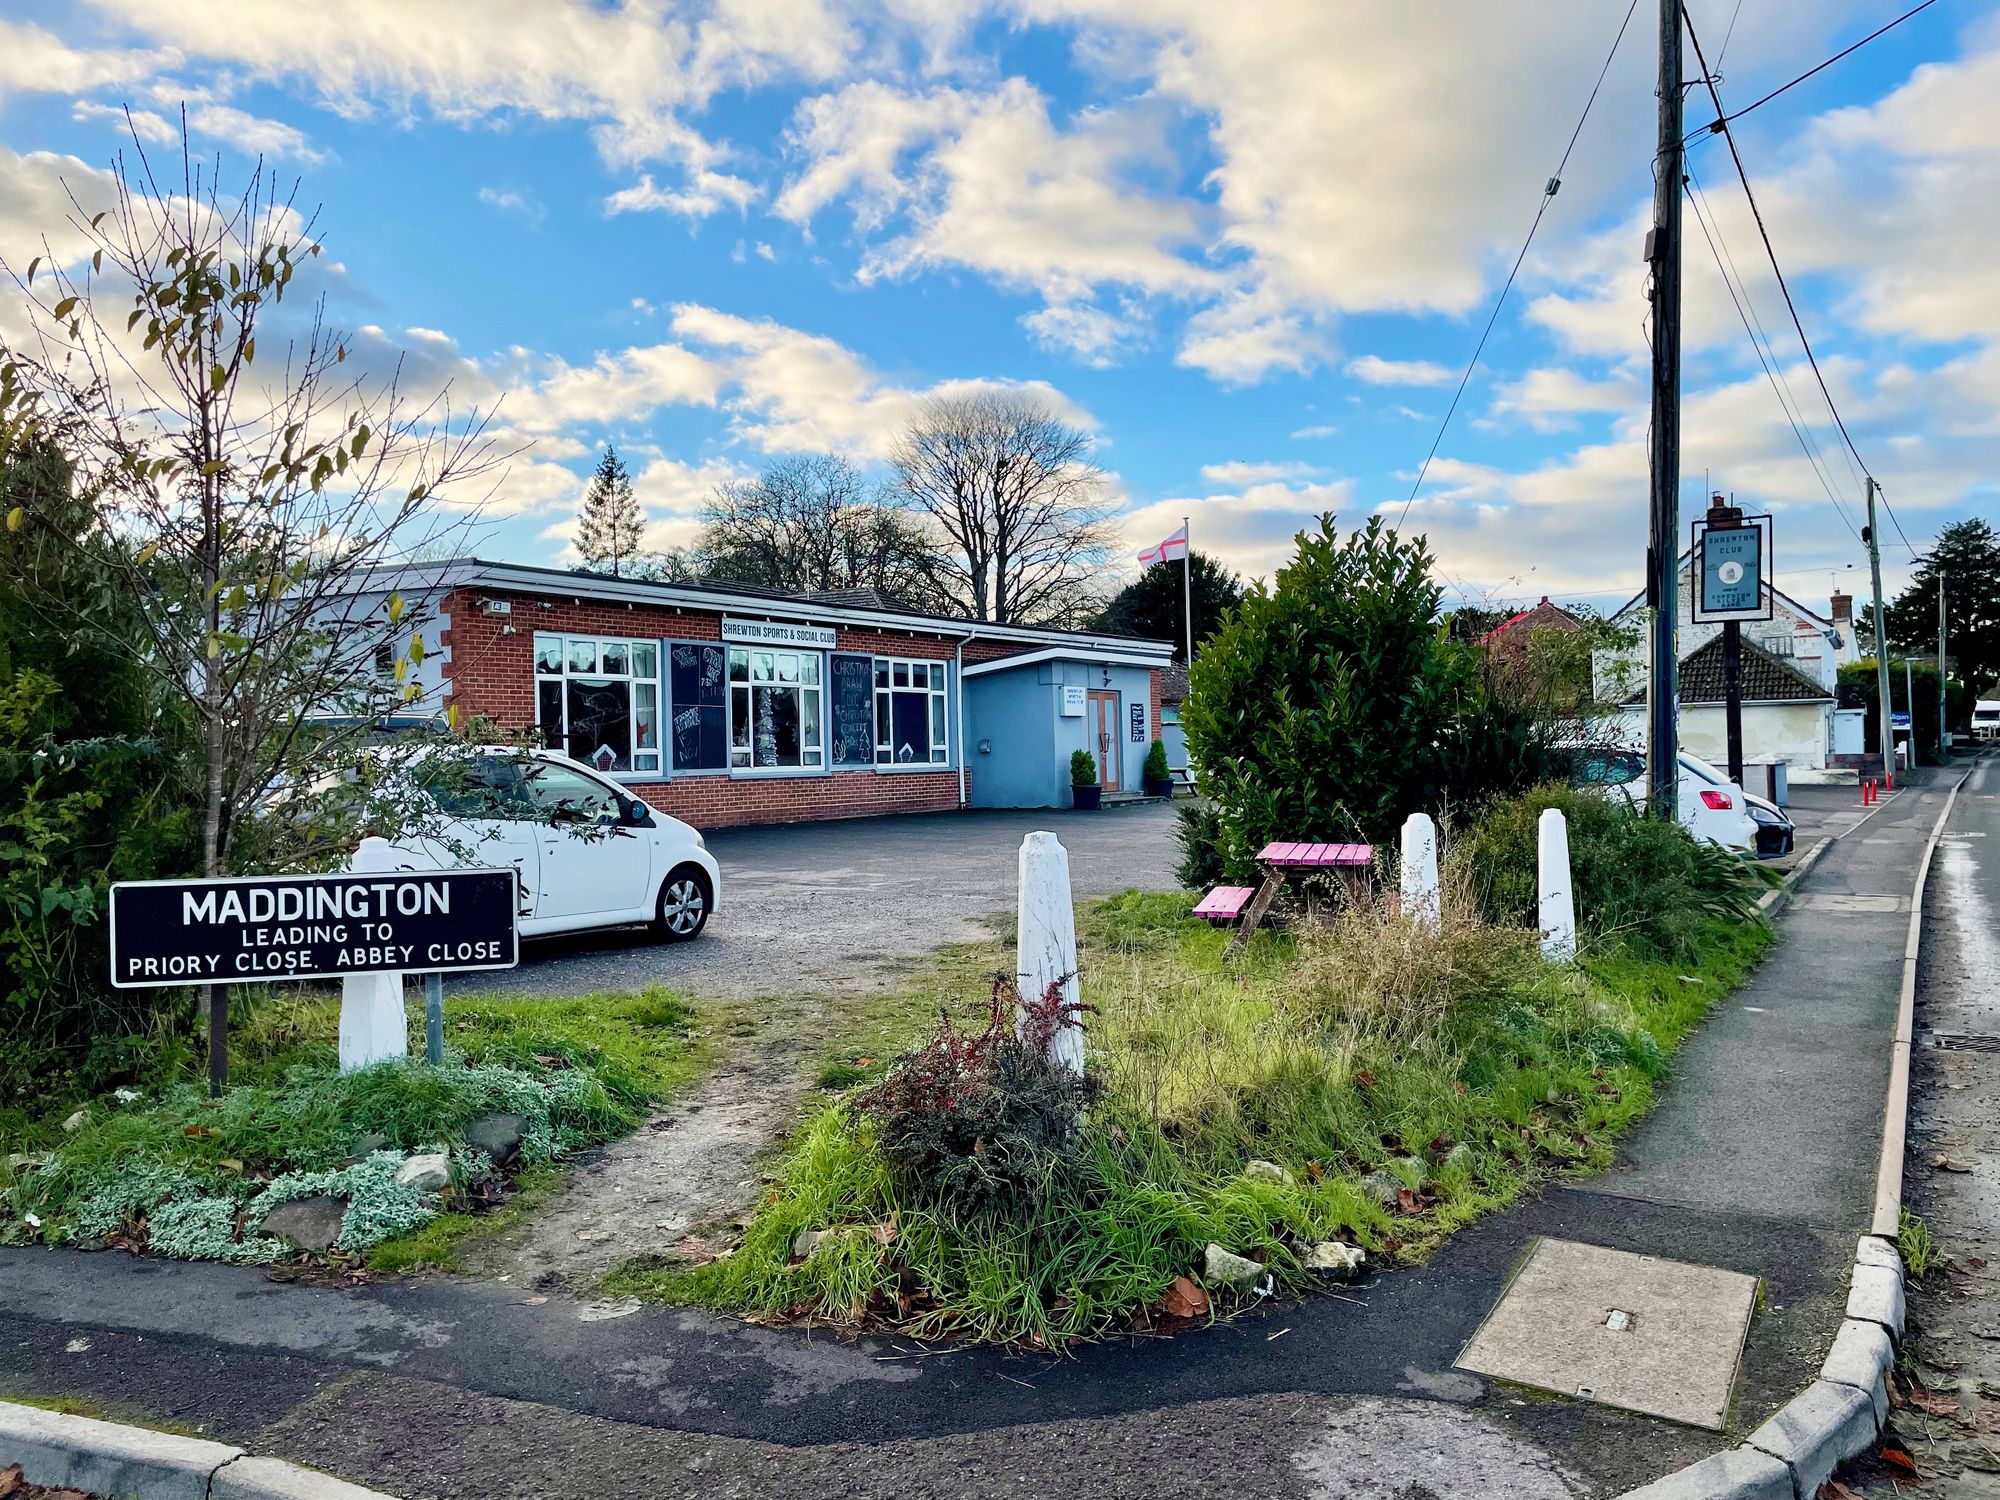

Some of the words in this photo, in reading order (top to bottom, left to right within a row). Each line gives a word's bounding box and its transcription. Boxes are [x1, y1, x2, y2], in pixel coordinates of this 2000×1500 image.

[723, 623, 761, 637] SHREWTON
[763, 627, 788, 640] SPORTS
[790, 629, 795, 639] &
[796, 630, 819, 643] SOCIAL
[820, 632, 835, 644] CLUB
[841, 677, 862, 689] DRAW
[182, 881, 450, 926] MADDINGTON
[242, 924, 348, 947] LEADING
[361, 922, 393, 941] TO
[129, 954, 221, 976] PRIORY
[336, 945, 414, 967] ABBEY
[427, 941, 502, 963] CLOSE
